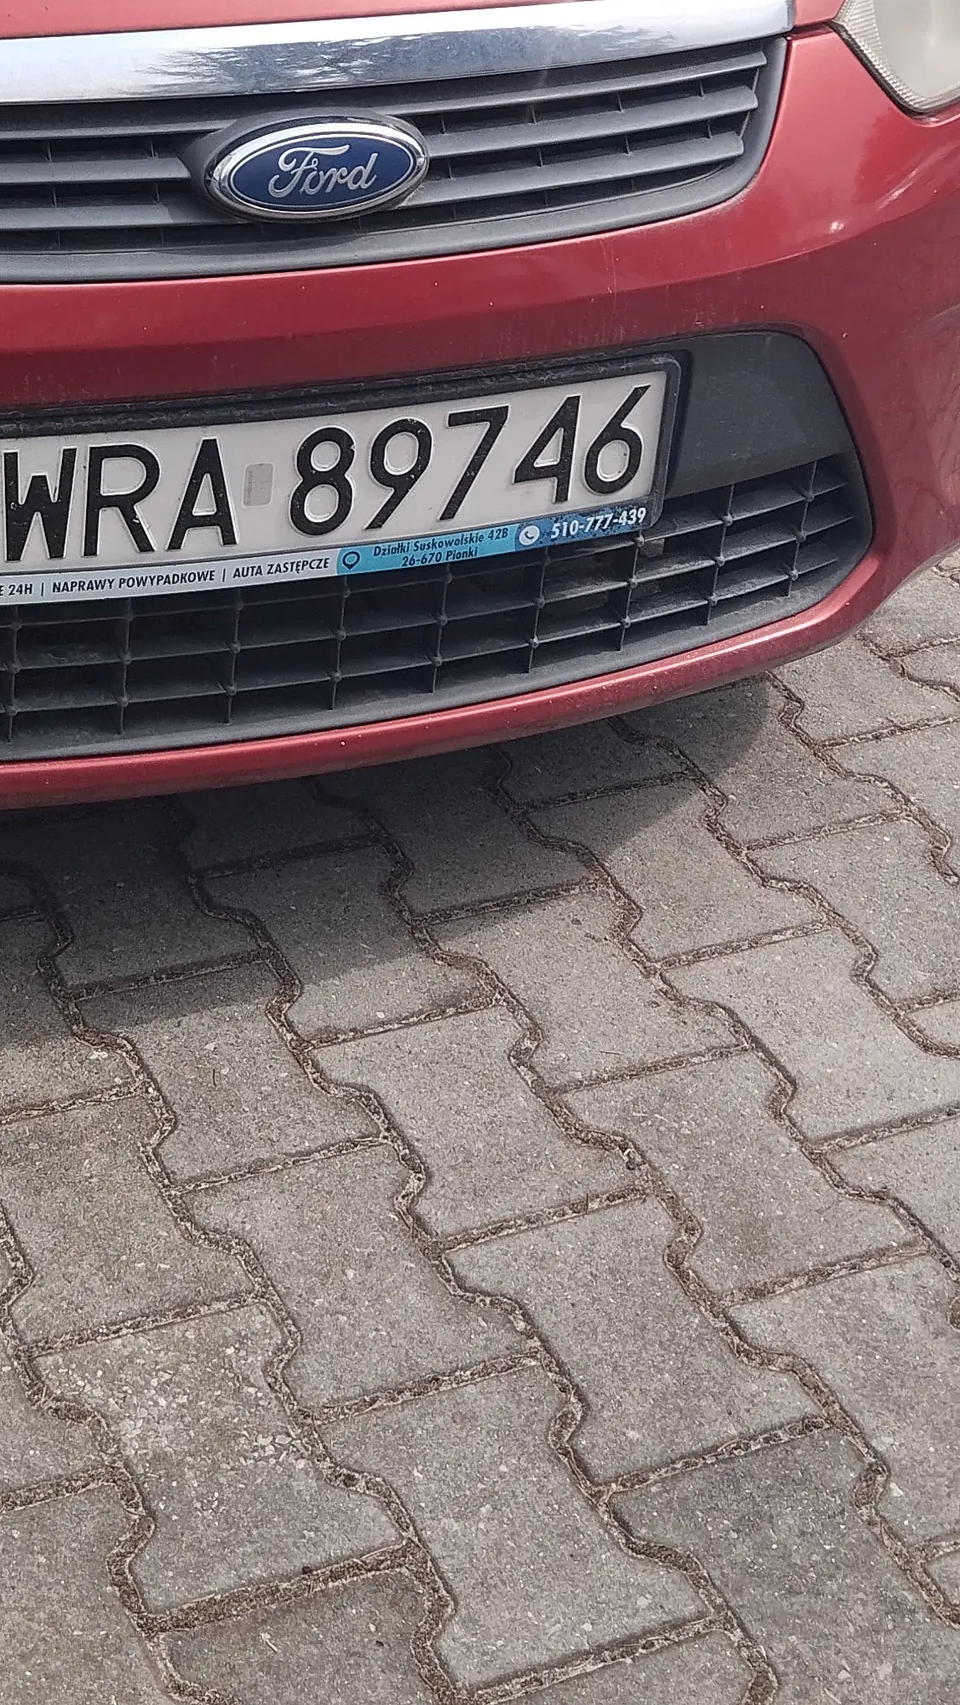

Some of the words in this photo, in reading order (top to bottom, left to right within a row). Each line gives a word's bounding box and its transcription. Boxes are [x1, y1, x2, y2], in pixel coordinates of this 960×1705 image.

[268, 144, 378, 198] Ford
[3, 437, 239, 562] WRA
[289, 384, 651, 536] 89746
[373, 541, 411, 557] Działki
[413, 533, 484, 553] Suskowolskie
[488, 527, 508, 542] 42B
[550, 507, 647, 540] 510-777-439
[401, 552, 441, 567] 26-670
[445, 546, 478, 561] Pionki
[8, 582, 33, 597] 24H
[52, 579, 116, 594] NAPRAWY
[118, 570, 215, 590] POWYPADKOWE
[232, 564, 264, 580] AUTA
[266, 556, 330, 576] ZASTĘPCZE
